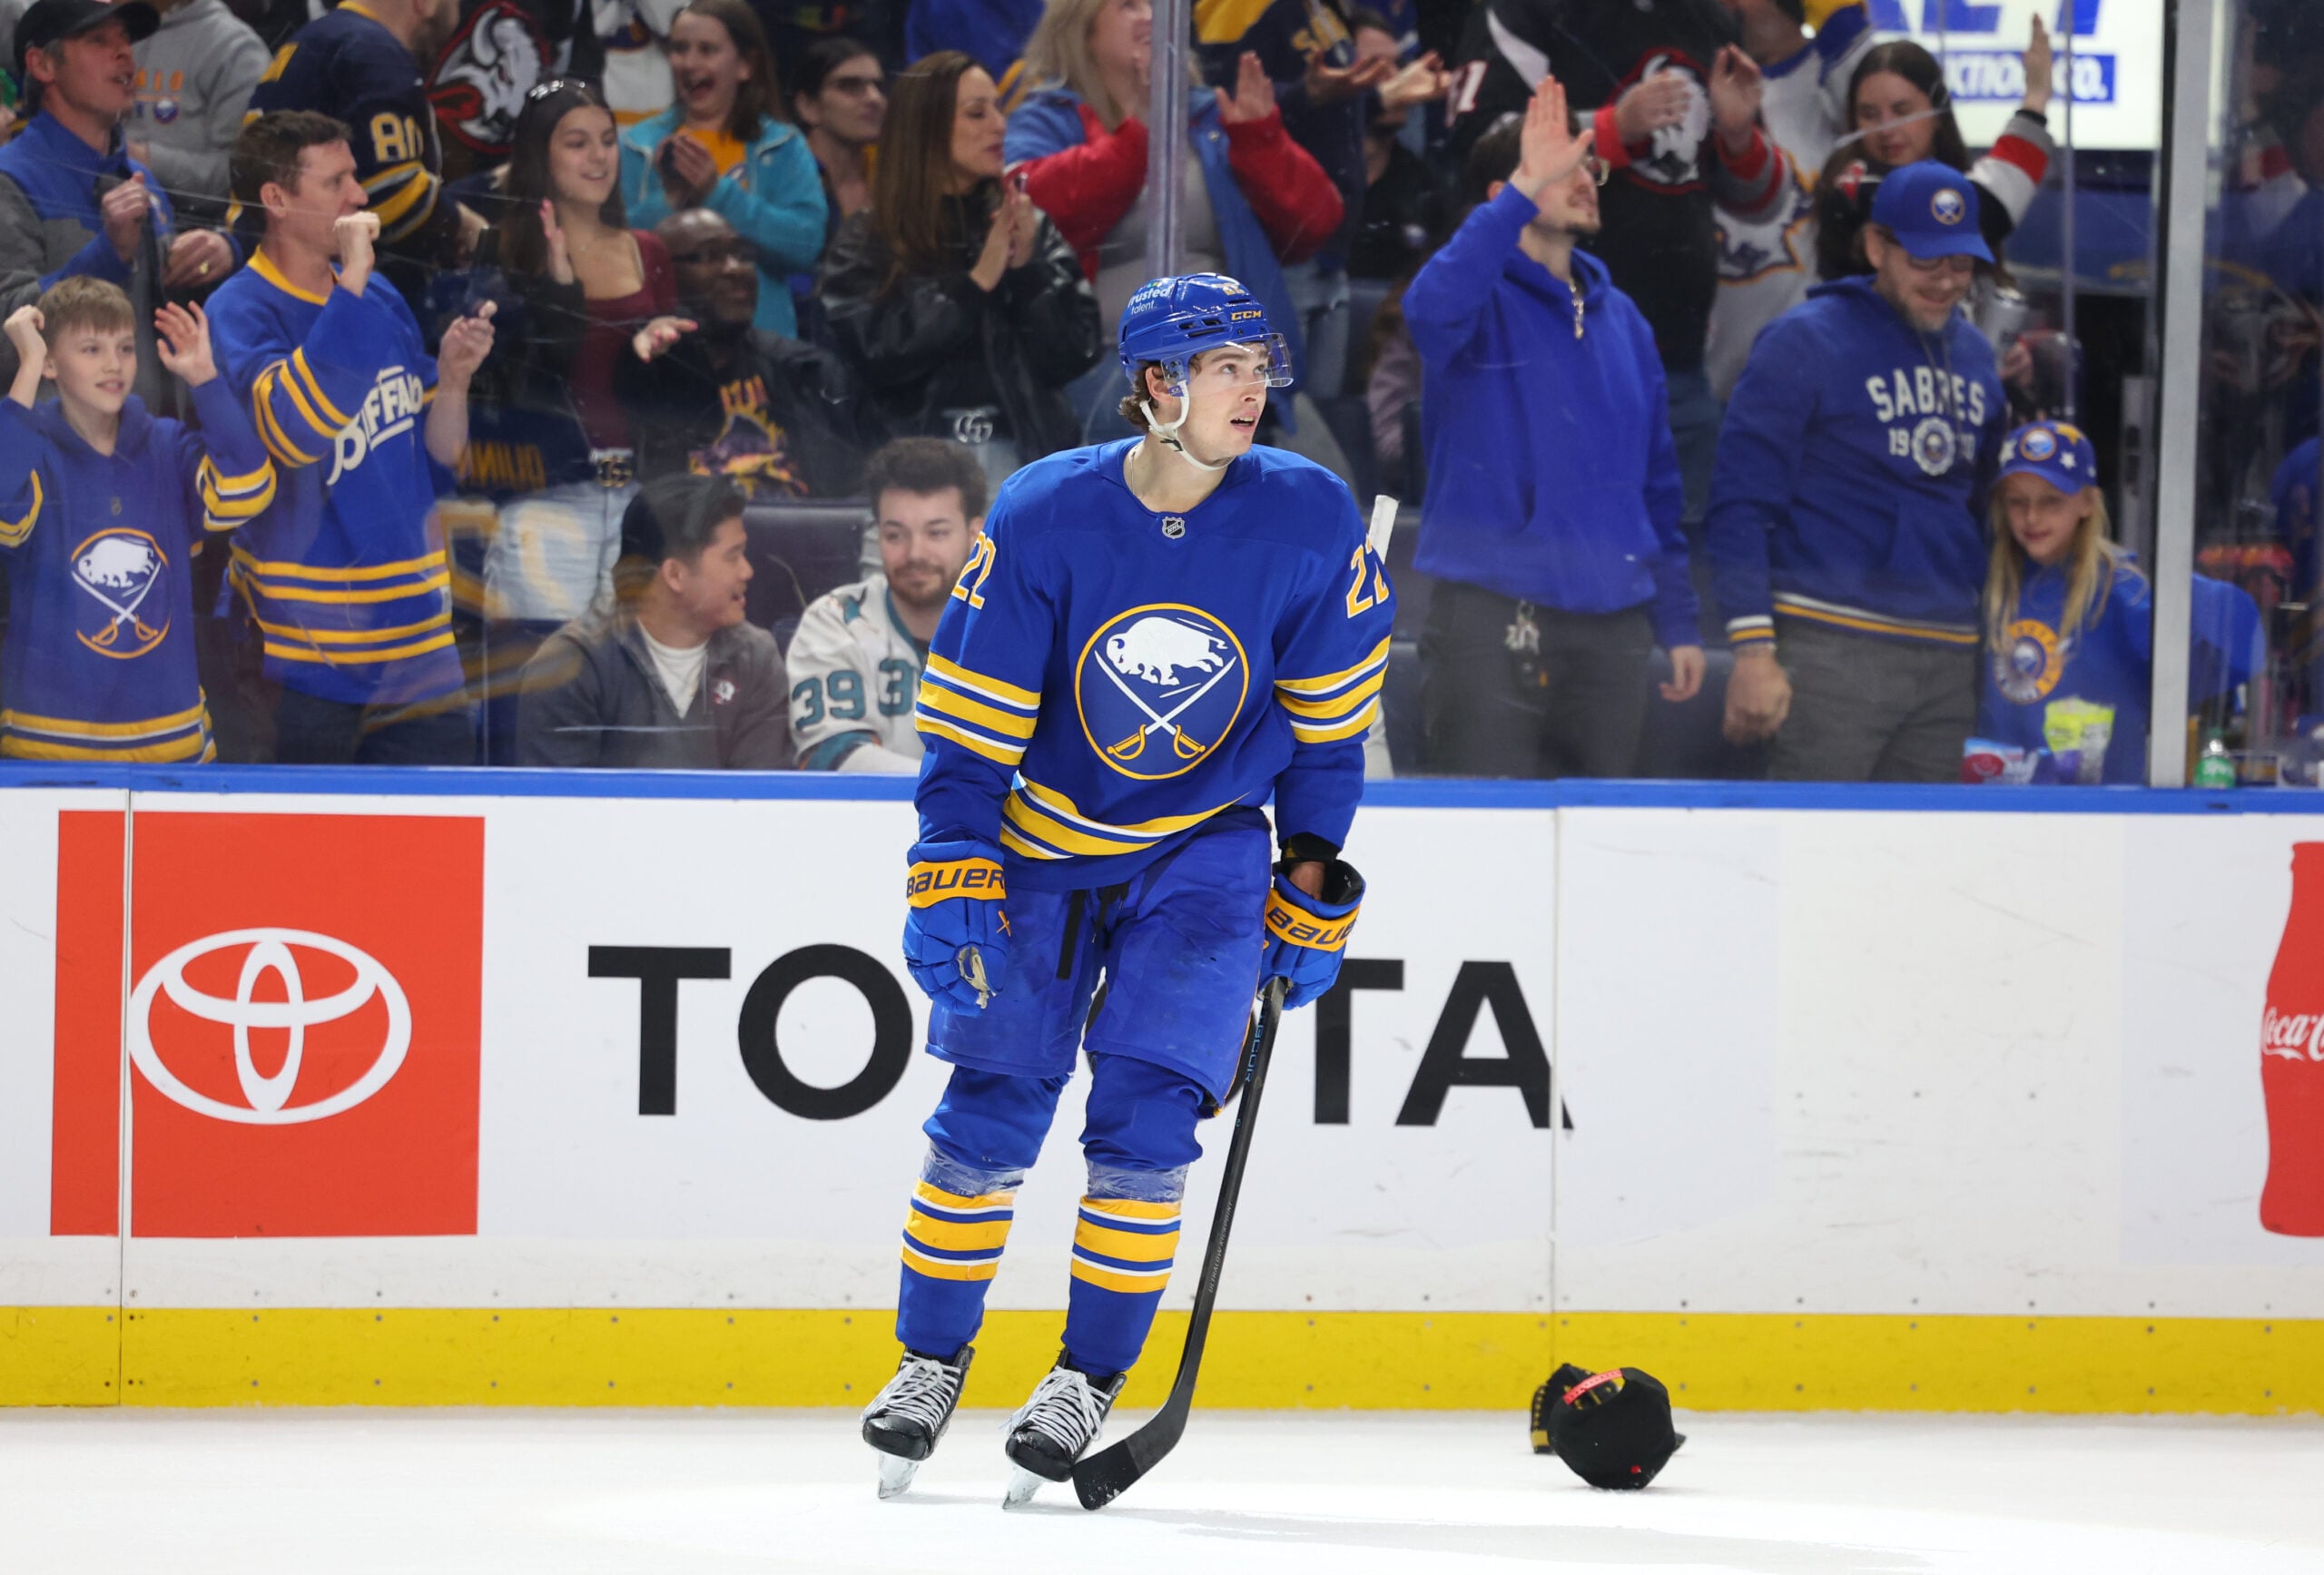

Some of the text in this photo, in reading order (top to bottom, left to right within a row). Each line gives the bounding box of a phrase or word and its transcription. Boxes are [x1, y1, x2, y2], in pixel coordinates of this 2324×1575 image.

[1231, 310, 1262, 320] CCM
[1865, 365, 1986, 427] SABRES
[1888, 428, 1910, 457] 19
[950, 530, 997, 610] 22
[792, 669, 866, 732] 39
[907, 869, 1005, 899] BAUER
[587, 942, 1574, 1131] TOTA
